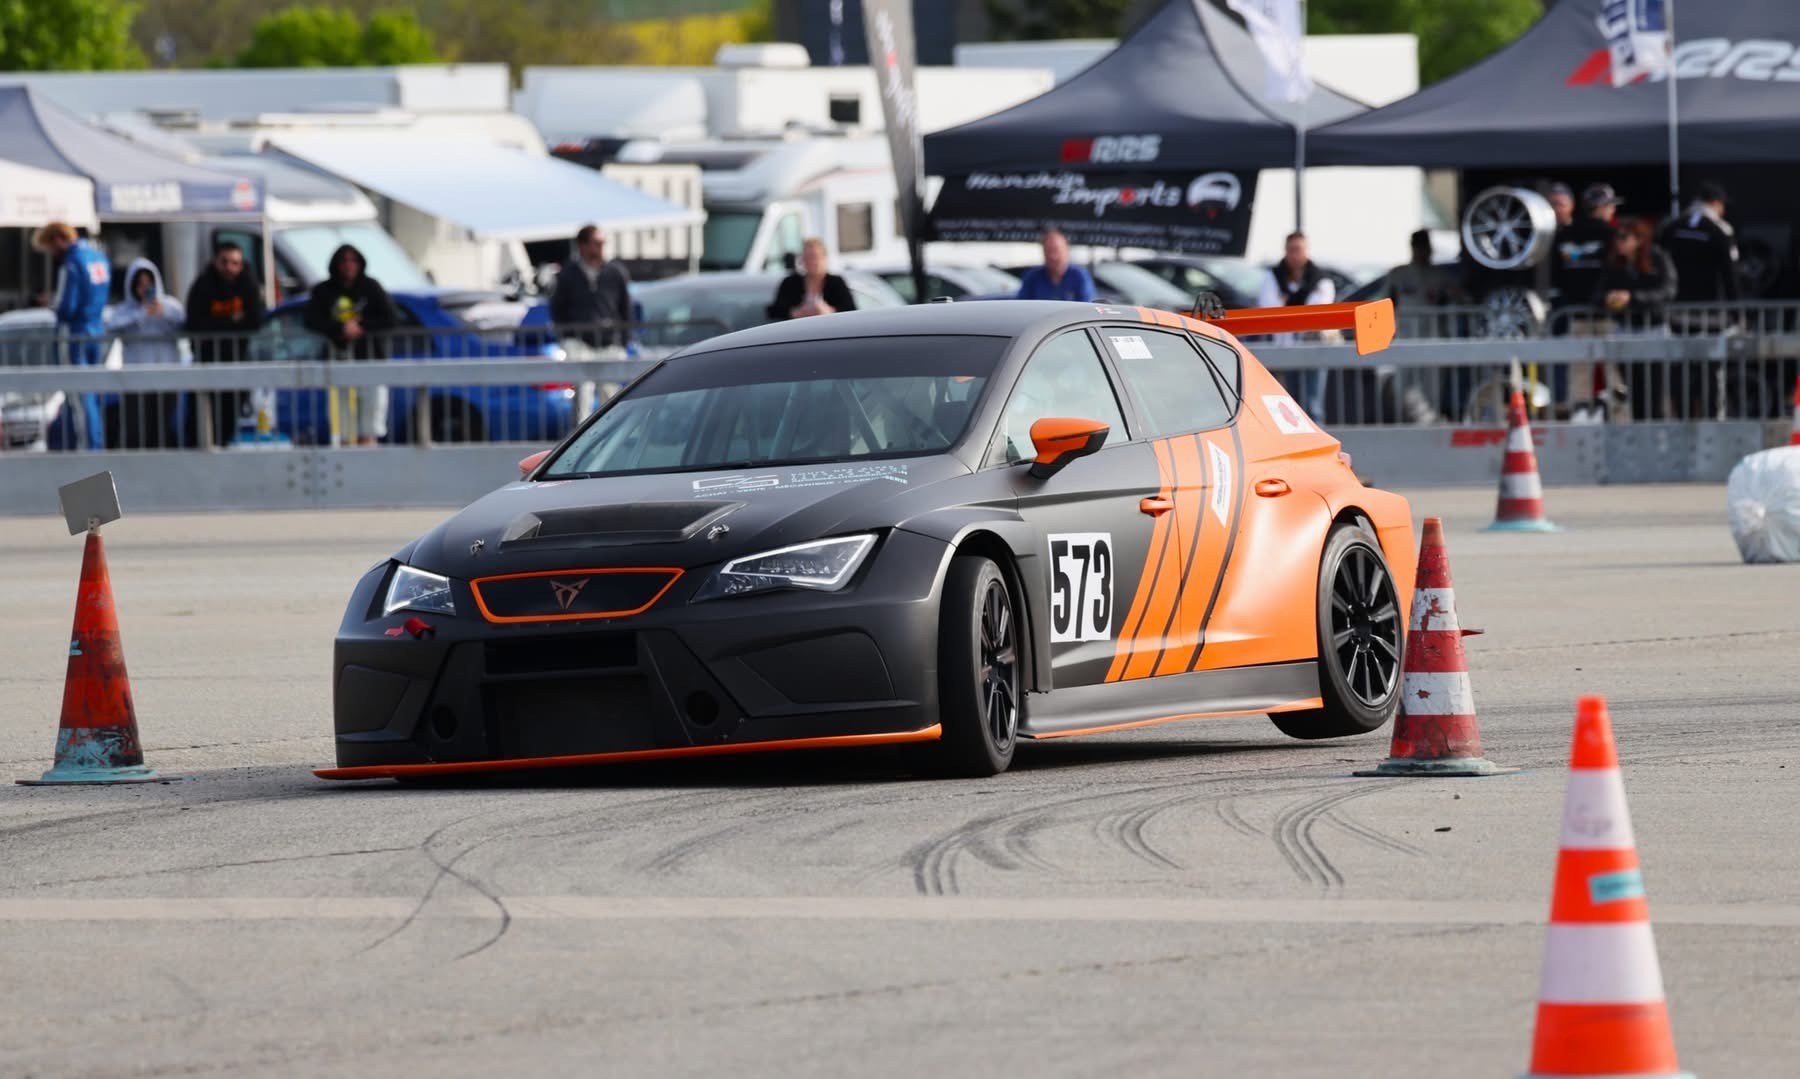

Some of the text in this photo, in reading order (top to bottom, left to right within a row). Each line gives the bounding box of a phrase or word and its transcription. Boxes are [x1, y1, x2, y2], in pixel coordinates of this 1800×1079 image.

[1091, 134, 1162, 164] RRS
[1053, 180, 1181, 217] Imports
[1050, 539, 1111, 639] 573
